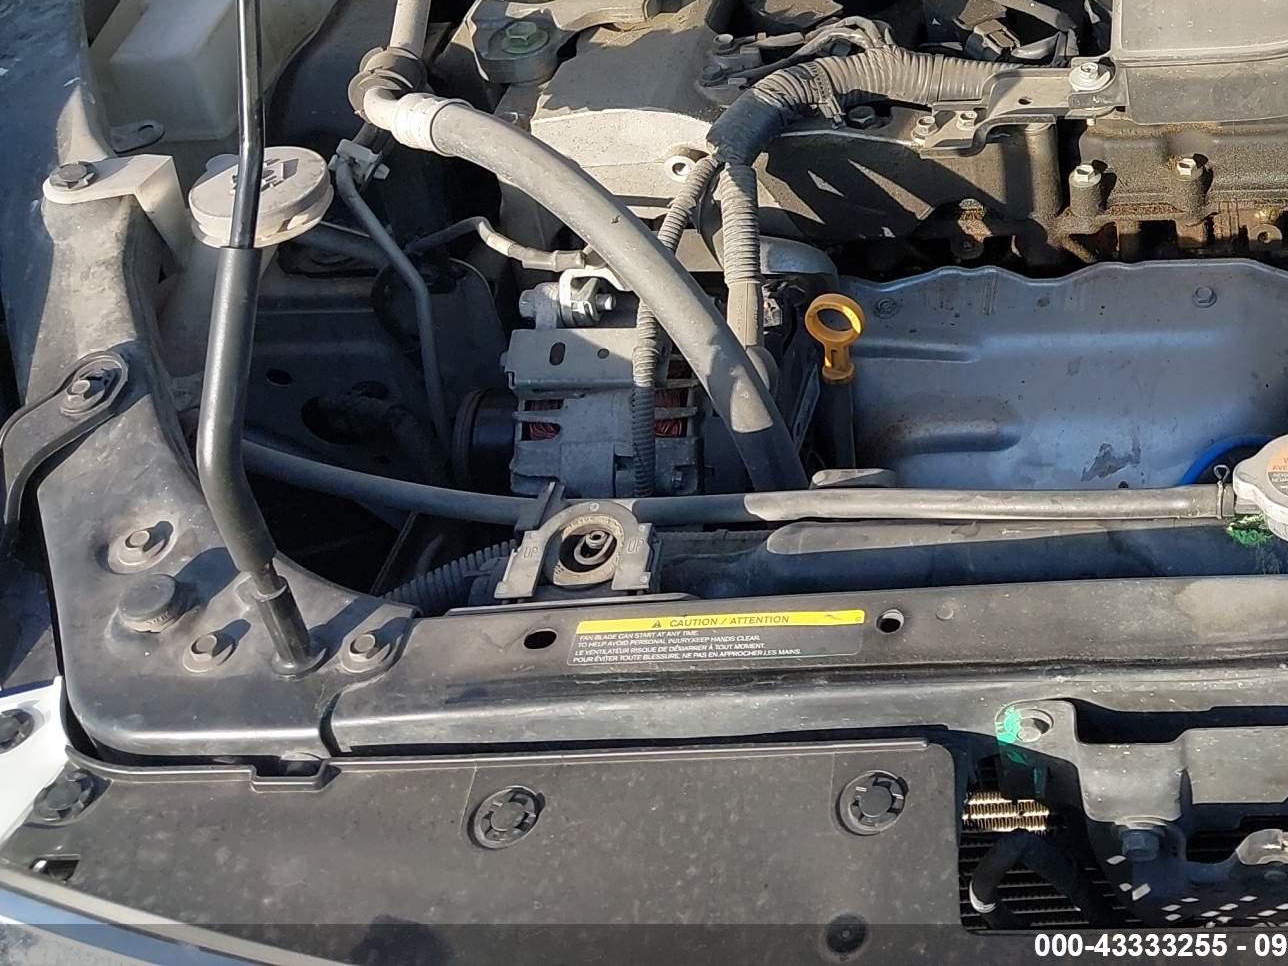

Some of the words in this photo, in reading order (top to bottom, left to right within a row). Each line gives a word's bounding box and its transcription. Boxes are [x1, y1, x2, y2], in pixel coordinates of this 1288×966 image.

[669, 618, 718, 627] CAUTION
[730, 616, 790, 625] ATTENTION
[630, 646, 657, 654] RISQUE
